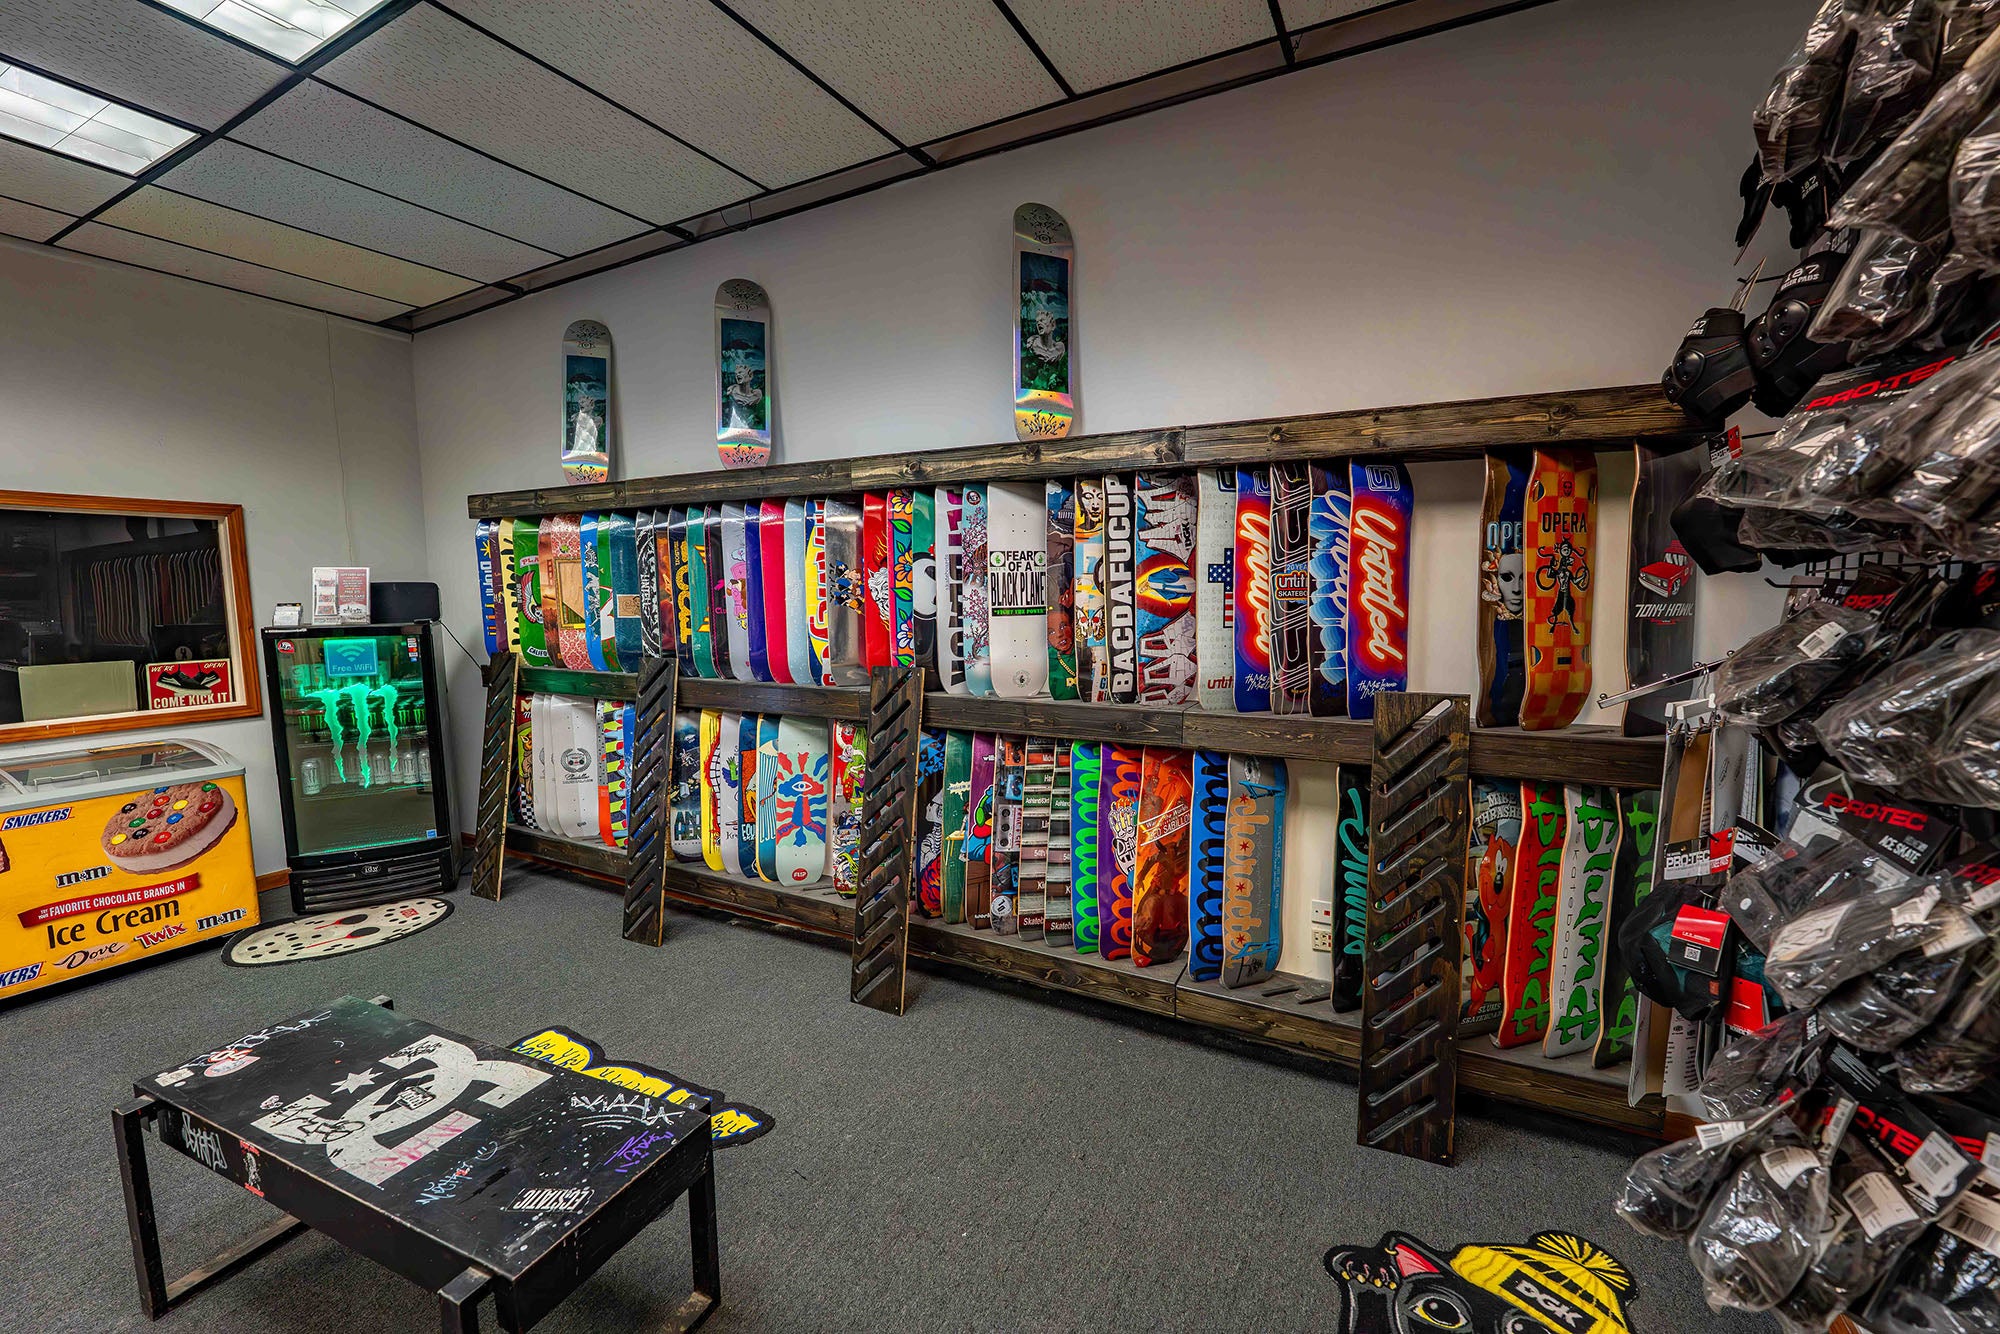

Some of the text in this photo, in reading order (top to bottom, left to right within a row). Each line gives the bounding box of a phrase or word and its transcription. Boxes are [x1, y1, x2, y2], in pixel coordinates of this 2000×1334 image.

[1786, 263, 1820, 283] 187
[1541, 511, 1587, 534] OPERA
[1486, 520, 1523, 550] OPE
[1006, 550, 1034, 562] FEAR
[1008, 561, 1033, 572] OF A
[990, 572, 1019, 607] BLACK
[1354, 509, 1404, 661] Untitled
[1635, 602, 1695, 618] TONY HAWK
[151, 664, 175, 673] WE'RE
[332, 664, 373, 673] Free WiFi
[153, 692, 228, 709] COME KICK IT
[3, 808, 71, 830] SNICKERS
[1823, 792, 1929, 832] PRO-TEC
[1666, 850, 1711, 869] PRO-TEC
[1895, 842, 1922, 865] SKATE
[49, 881, 186, 918] FAVORITE CHOCOLATE BRANDS IN
[47, 899, 180, 950] Ice Cream
[512, 1188, 591, 1212] ECSTATIC
[1514, 1278, 1583, 1328] DGK
